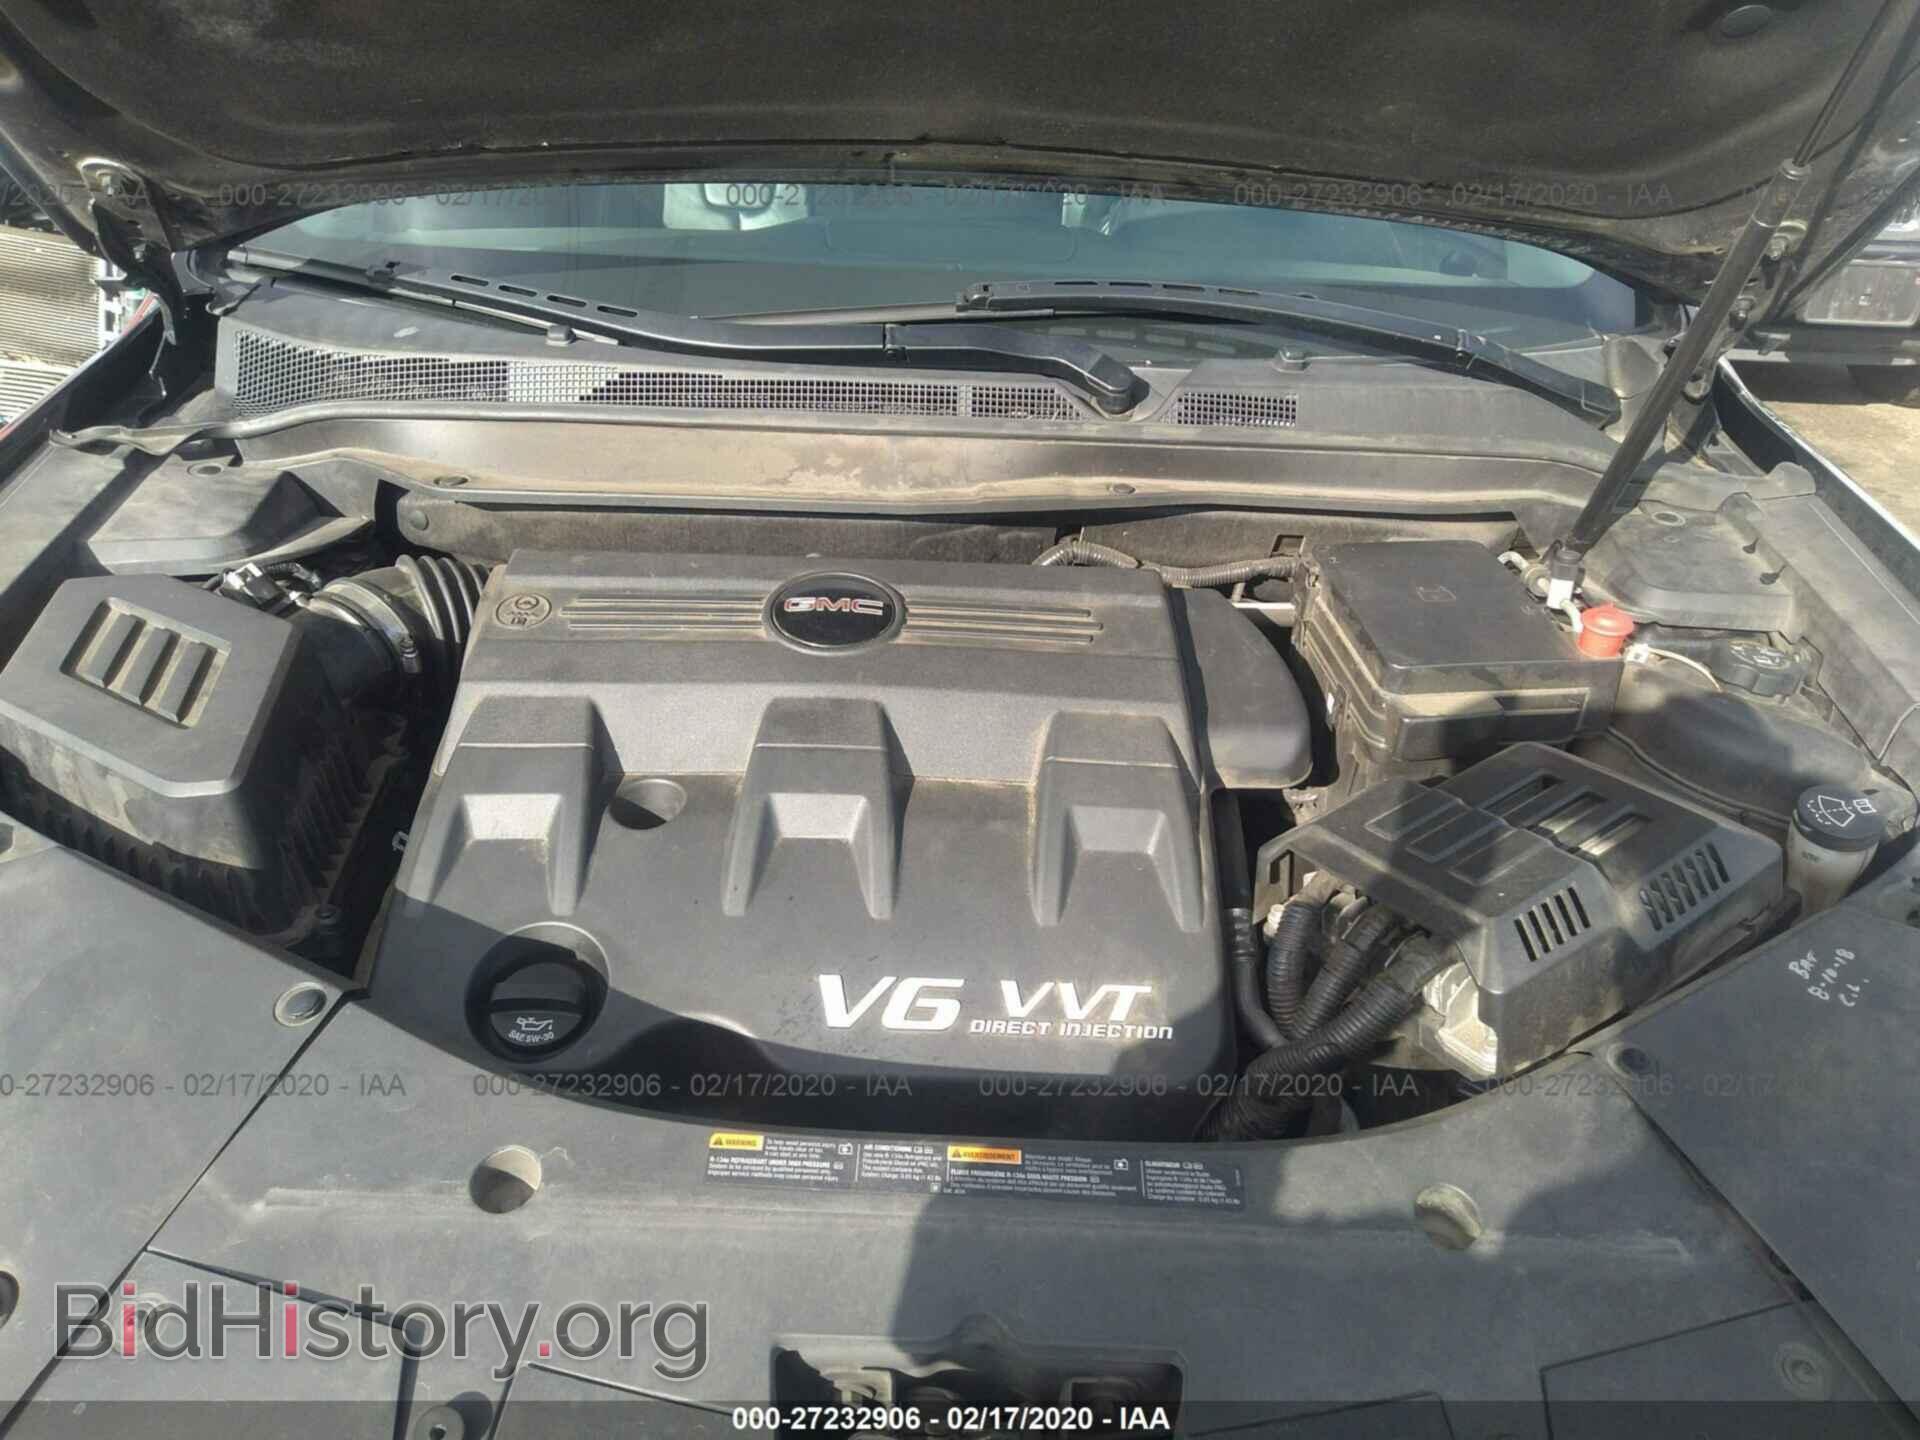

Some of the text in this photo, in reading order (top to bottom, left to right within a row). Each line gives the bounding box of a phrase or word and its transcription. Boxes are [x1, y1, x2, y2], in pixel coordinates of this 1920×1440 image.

[784, 597, 883, 615] GMC
[819, 974, 1152, 1031] V6 VVT
[969, 1020, 1052, 1037] DIRECT
